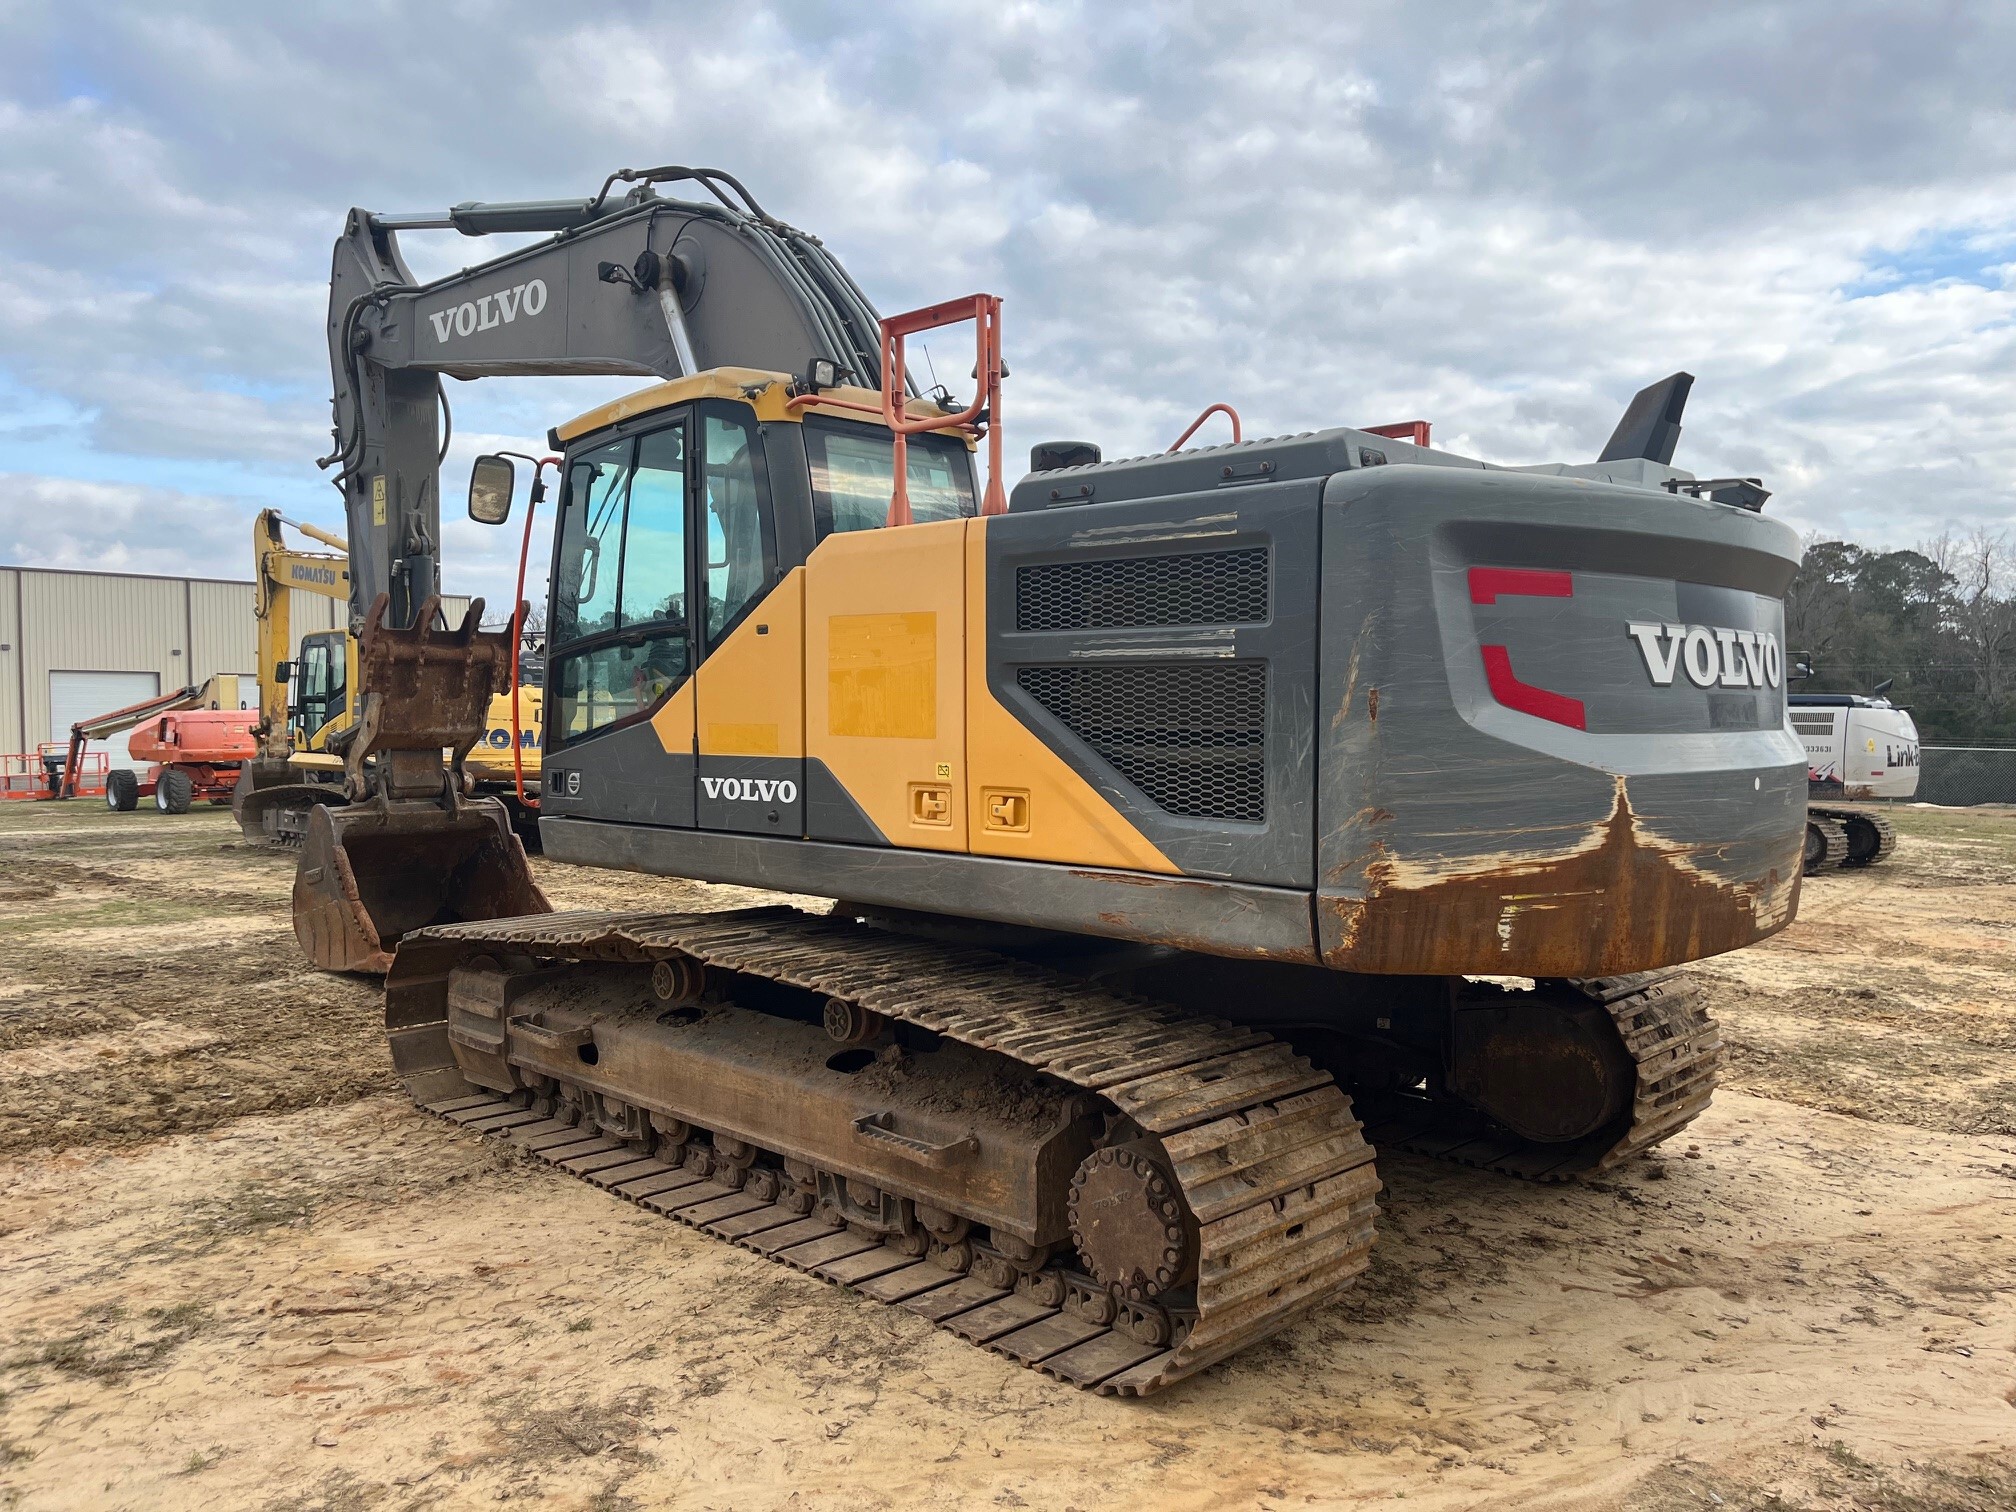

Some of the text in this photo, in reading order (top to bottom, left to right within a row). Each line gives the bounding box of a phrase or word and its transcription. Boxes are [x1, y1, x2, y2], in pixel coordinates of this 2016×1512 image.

[429, 278, 548, 343] VOLVO
[291, 564, 336, 586] KOMATSU
[1625, 619, 1780, 689] VOLVO
[700, 777, 797, 804] VOLVO
